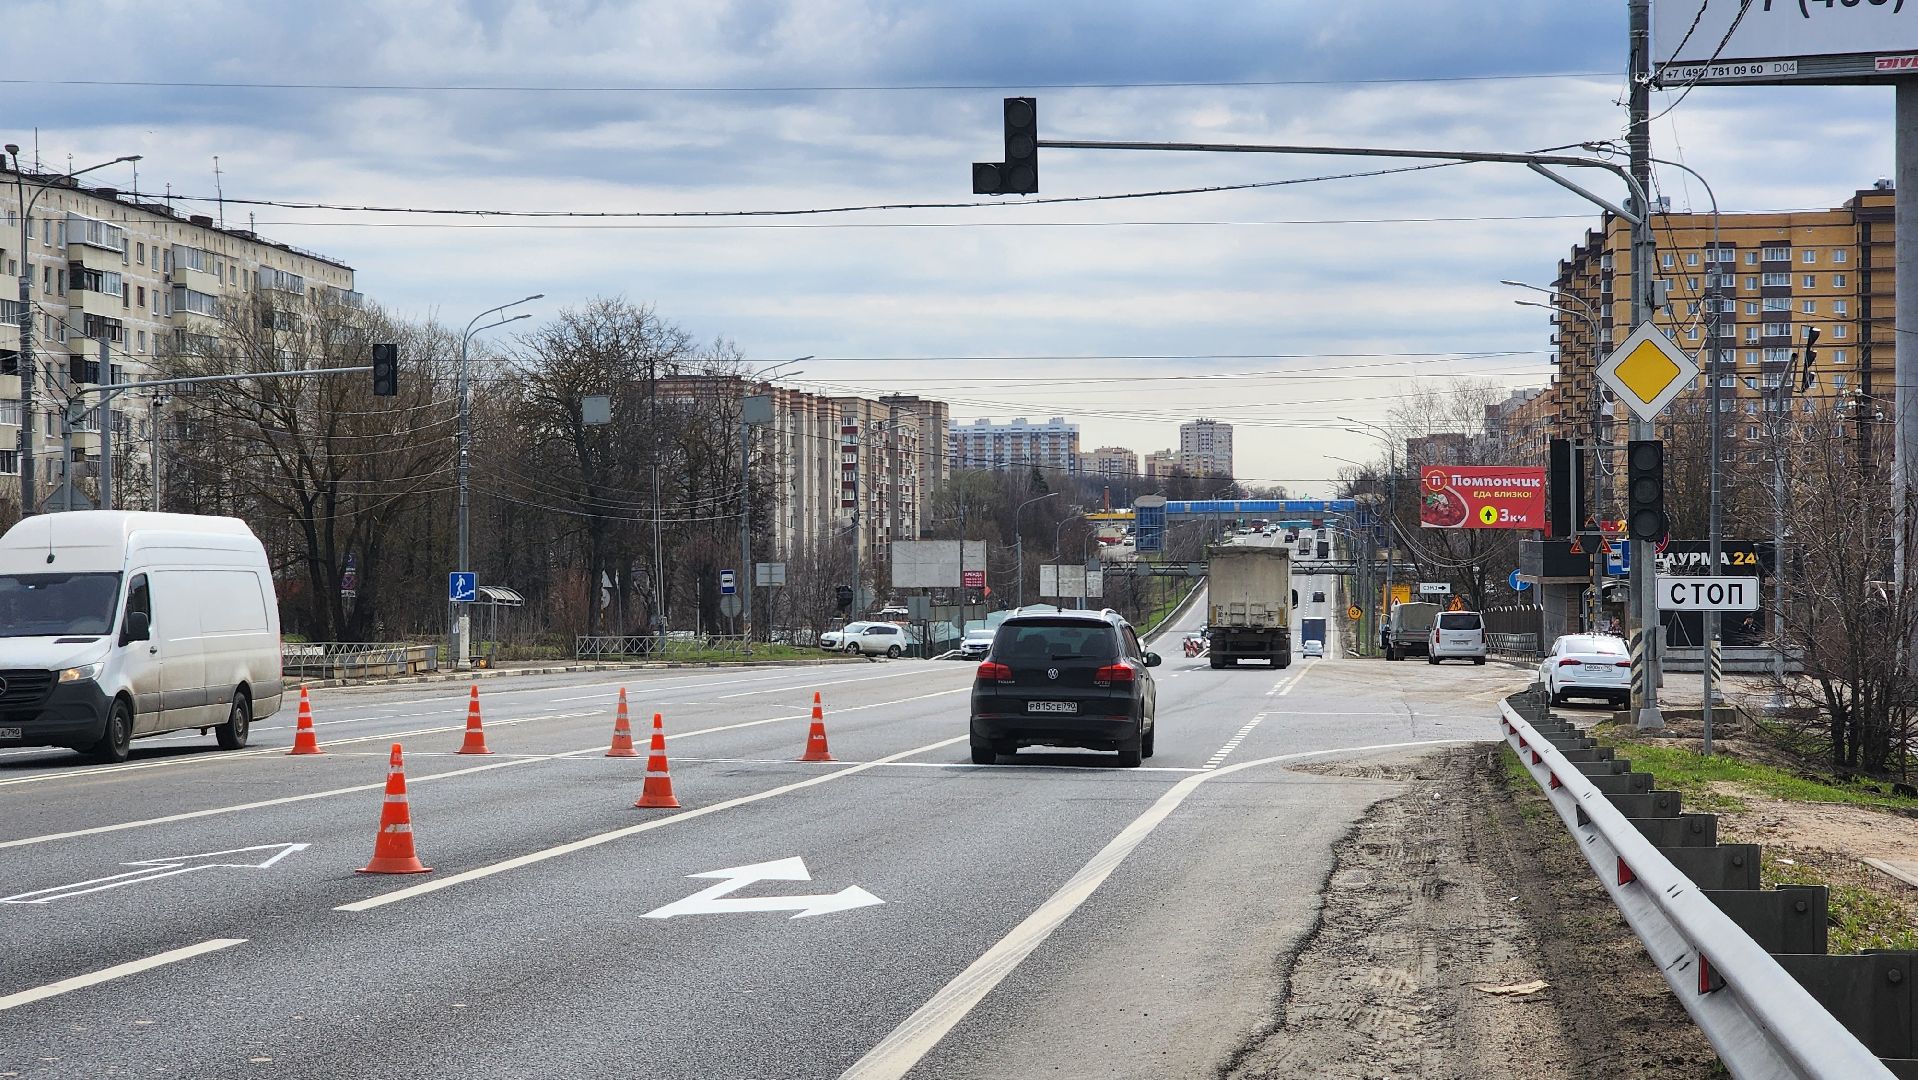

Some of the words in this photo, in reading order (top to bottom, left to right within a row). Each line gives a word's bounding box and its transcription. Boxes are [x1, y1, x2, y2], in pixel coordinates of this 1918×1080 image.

[1666, 69, 1679, 78] +7
[1712, 67, 1730, 76] 781
[1734, 66, 1747, 75] 09
[1750, 65, 1763, 74] 60
[1775, 63, 1795, 73] D04
[1451, 474, 1541, 487] Помпончик
[1473, 491, 1491, 499] ЕДА
[1733, 551, 1757, 566] 24
[1670, 583, 1743, 605] СТОП
